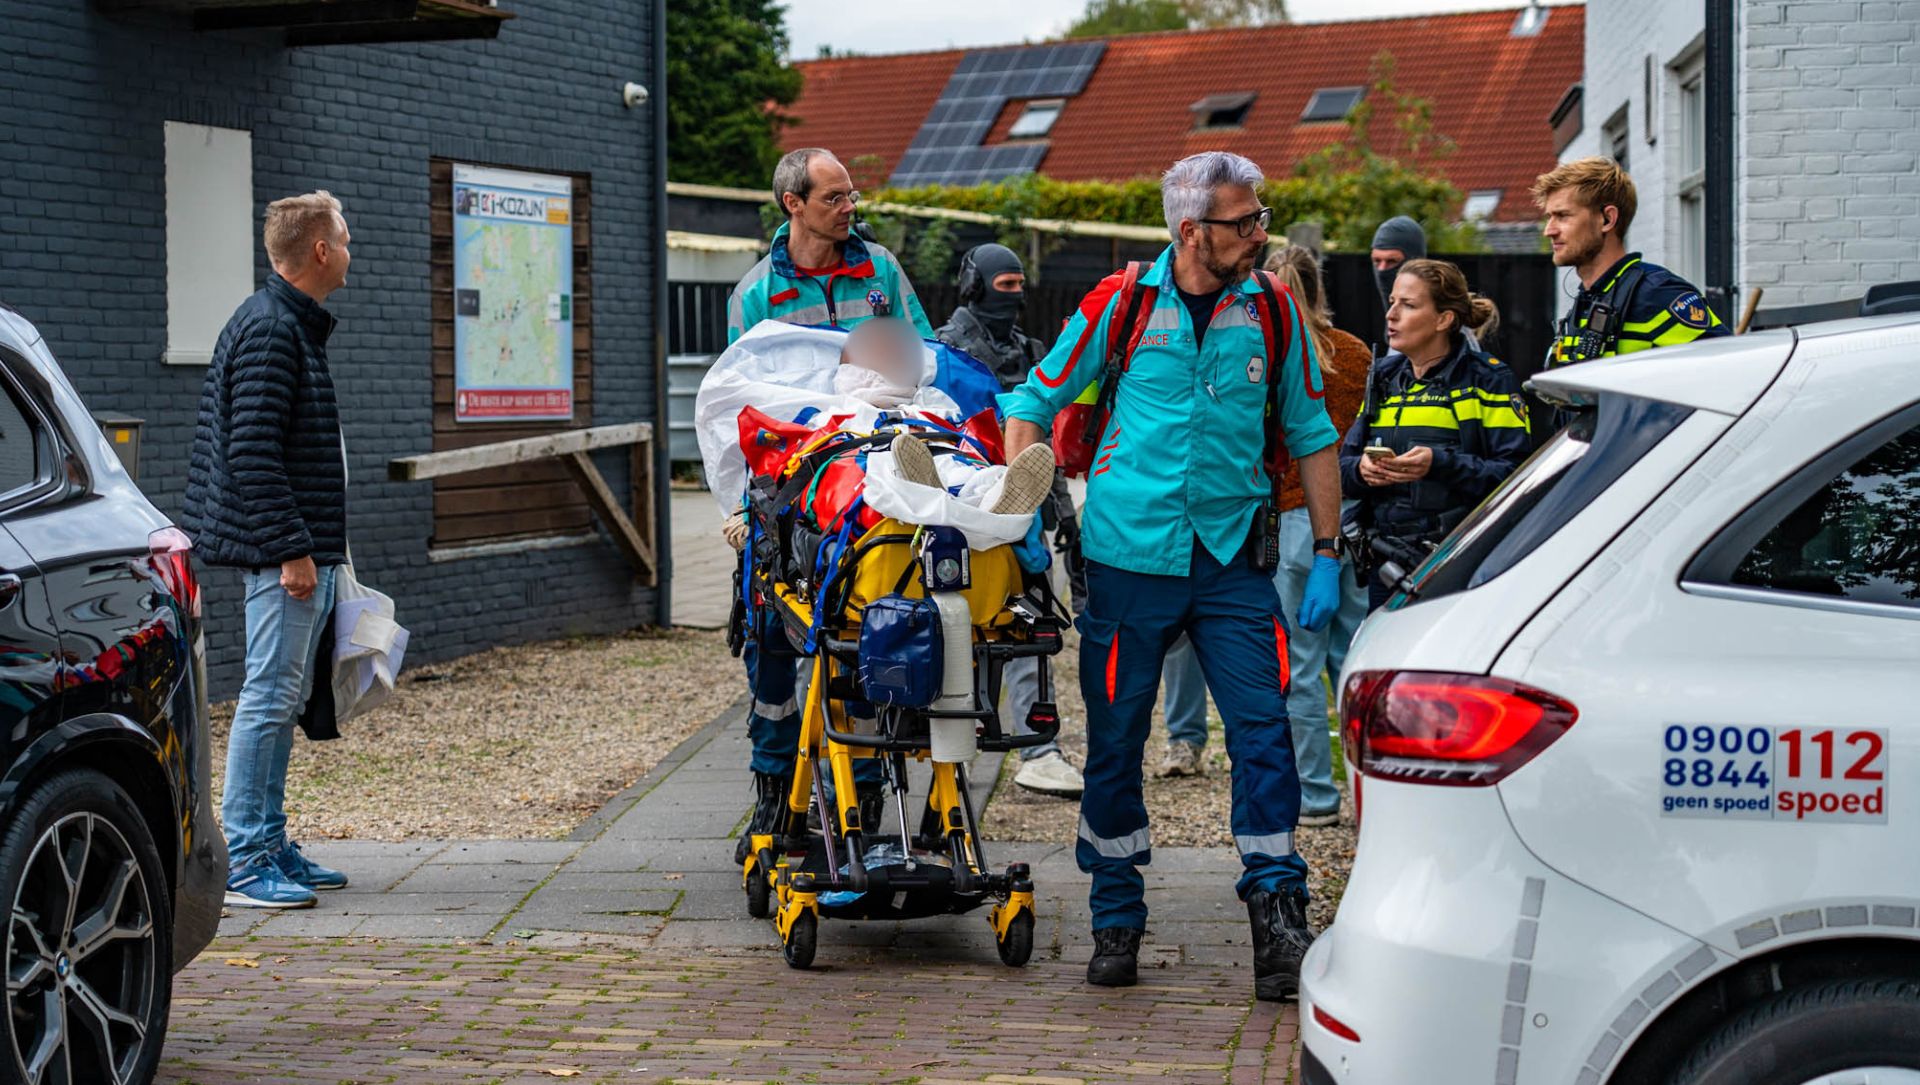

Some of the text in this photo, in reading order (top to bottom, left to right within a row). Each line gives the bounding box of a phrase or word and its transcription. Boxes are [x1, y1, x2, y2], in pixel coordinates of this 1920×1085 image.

[1138, 333, 1169, 347] ANCE
[1664, 725, 1770, 754] 0900
[1778, 729, 1883, 780] 112
[1663, 758, 1770, 788] 8844
[1663, 795, 1770, 813] geen spoed
[1777, 786, 1883, 820] spoed
